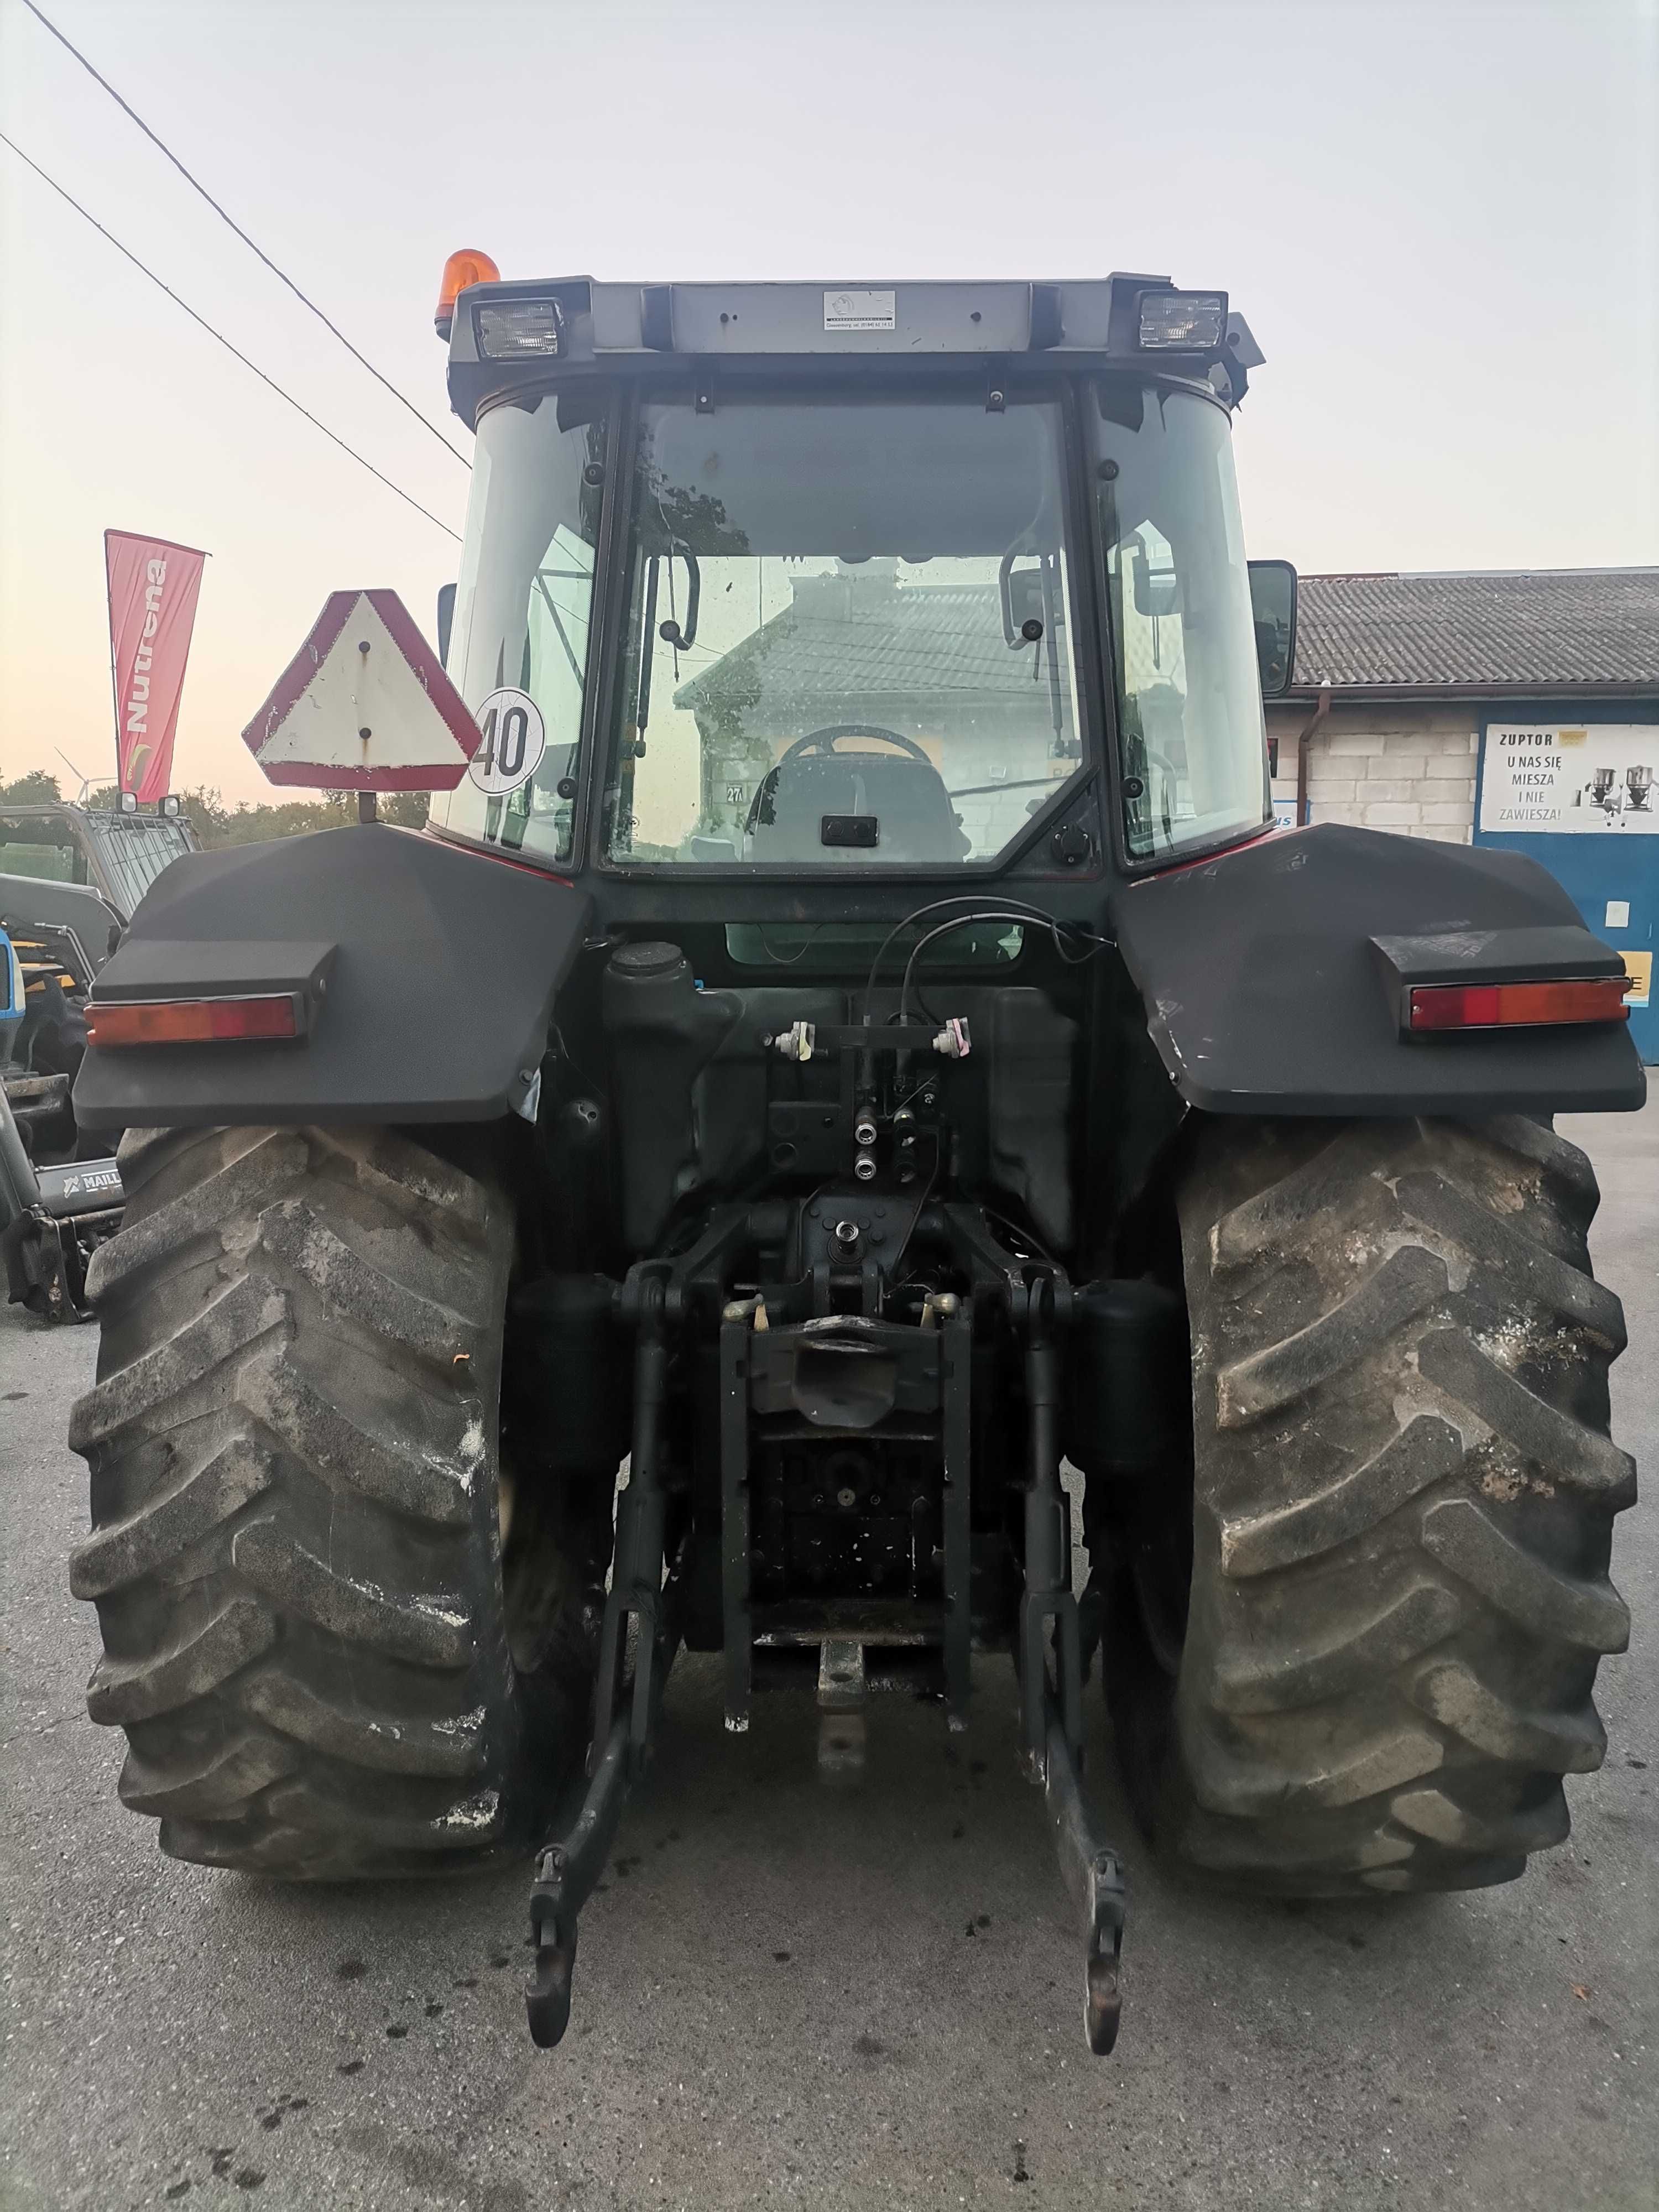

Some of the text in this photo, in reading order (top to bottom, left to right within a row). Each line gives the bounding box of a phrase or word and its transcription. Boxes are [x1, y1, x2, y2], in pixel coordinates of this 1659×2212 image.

[127, 559, 166, 733] Nutrena
[472, 707, 528, 776] 40
[1499, 734, 1552, 746] ZUPTOR
[1507, 756, 1562, 771] U NAS SIĘ
[1511, 774, 1554, 785] MIESZA
[1519, 791, 1545, 803] I NIE
[1499, 808, 1561, 821] ZAWIESZA!
[84, 1173, 122, 1188] MAILL
